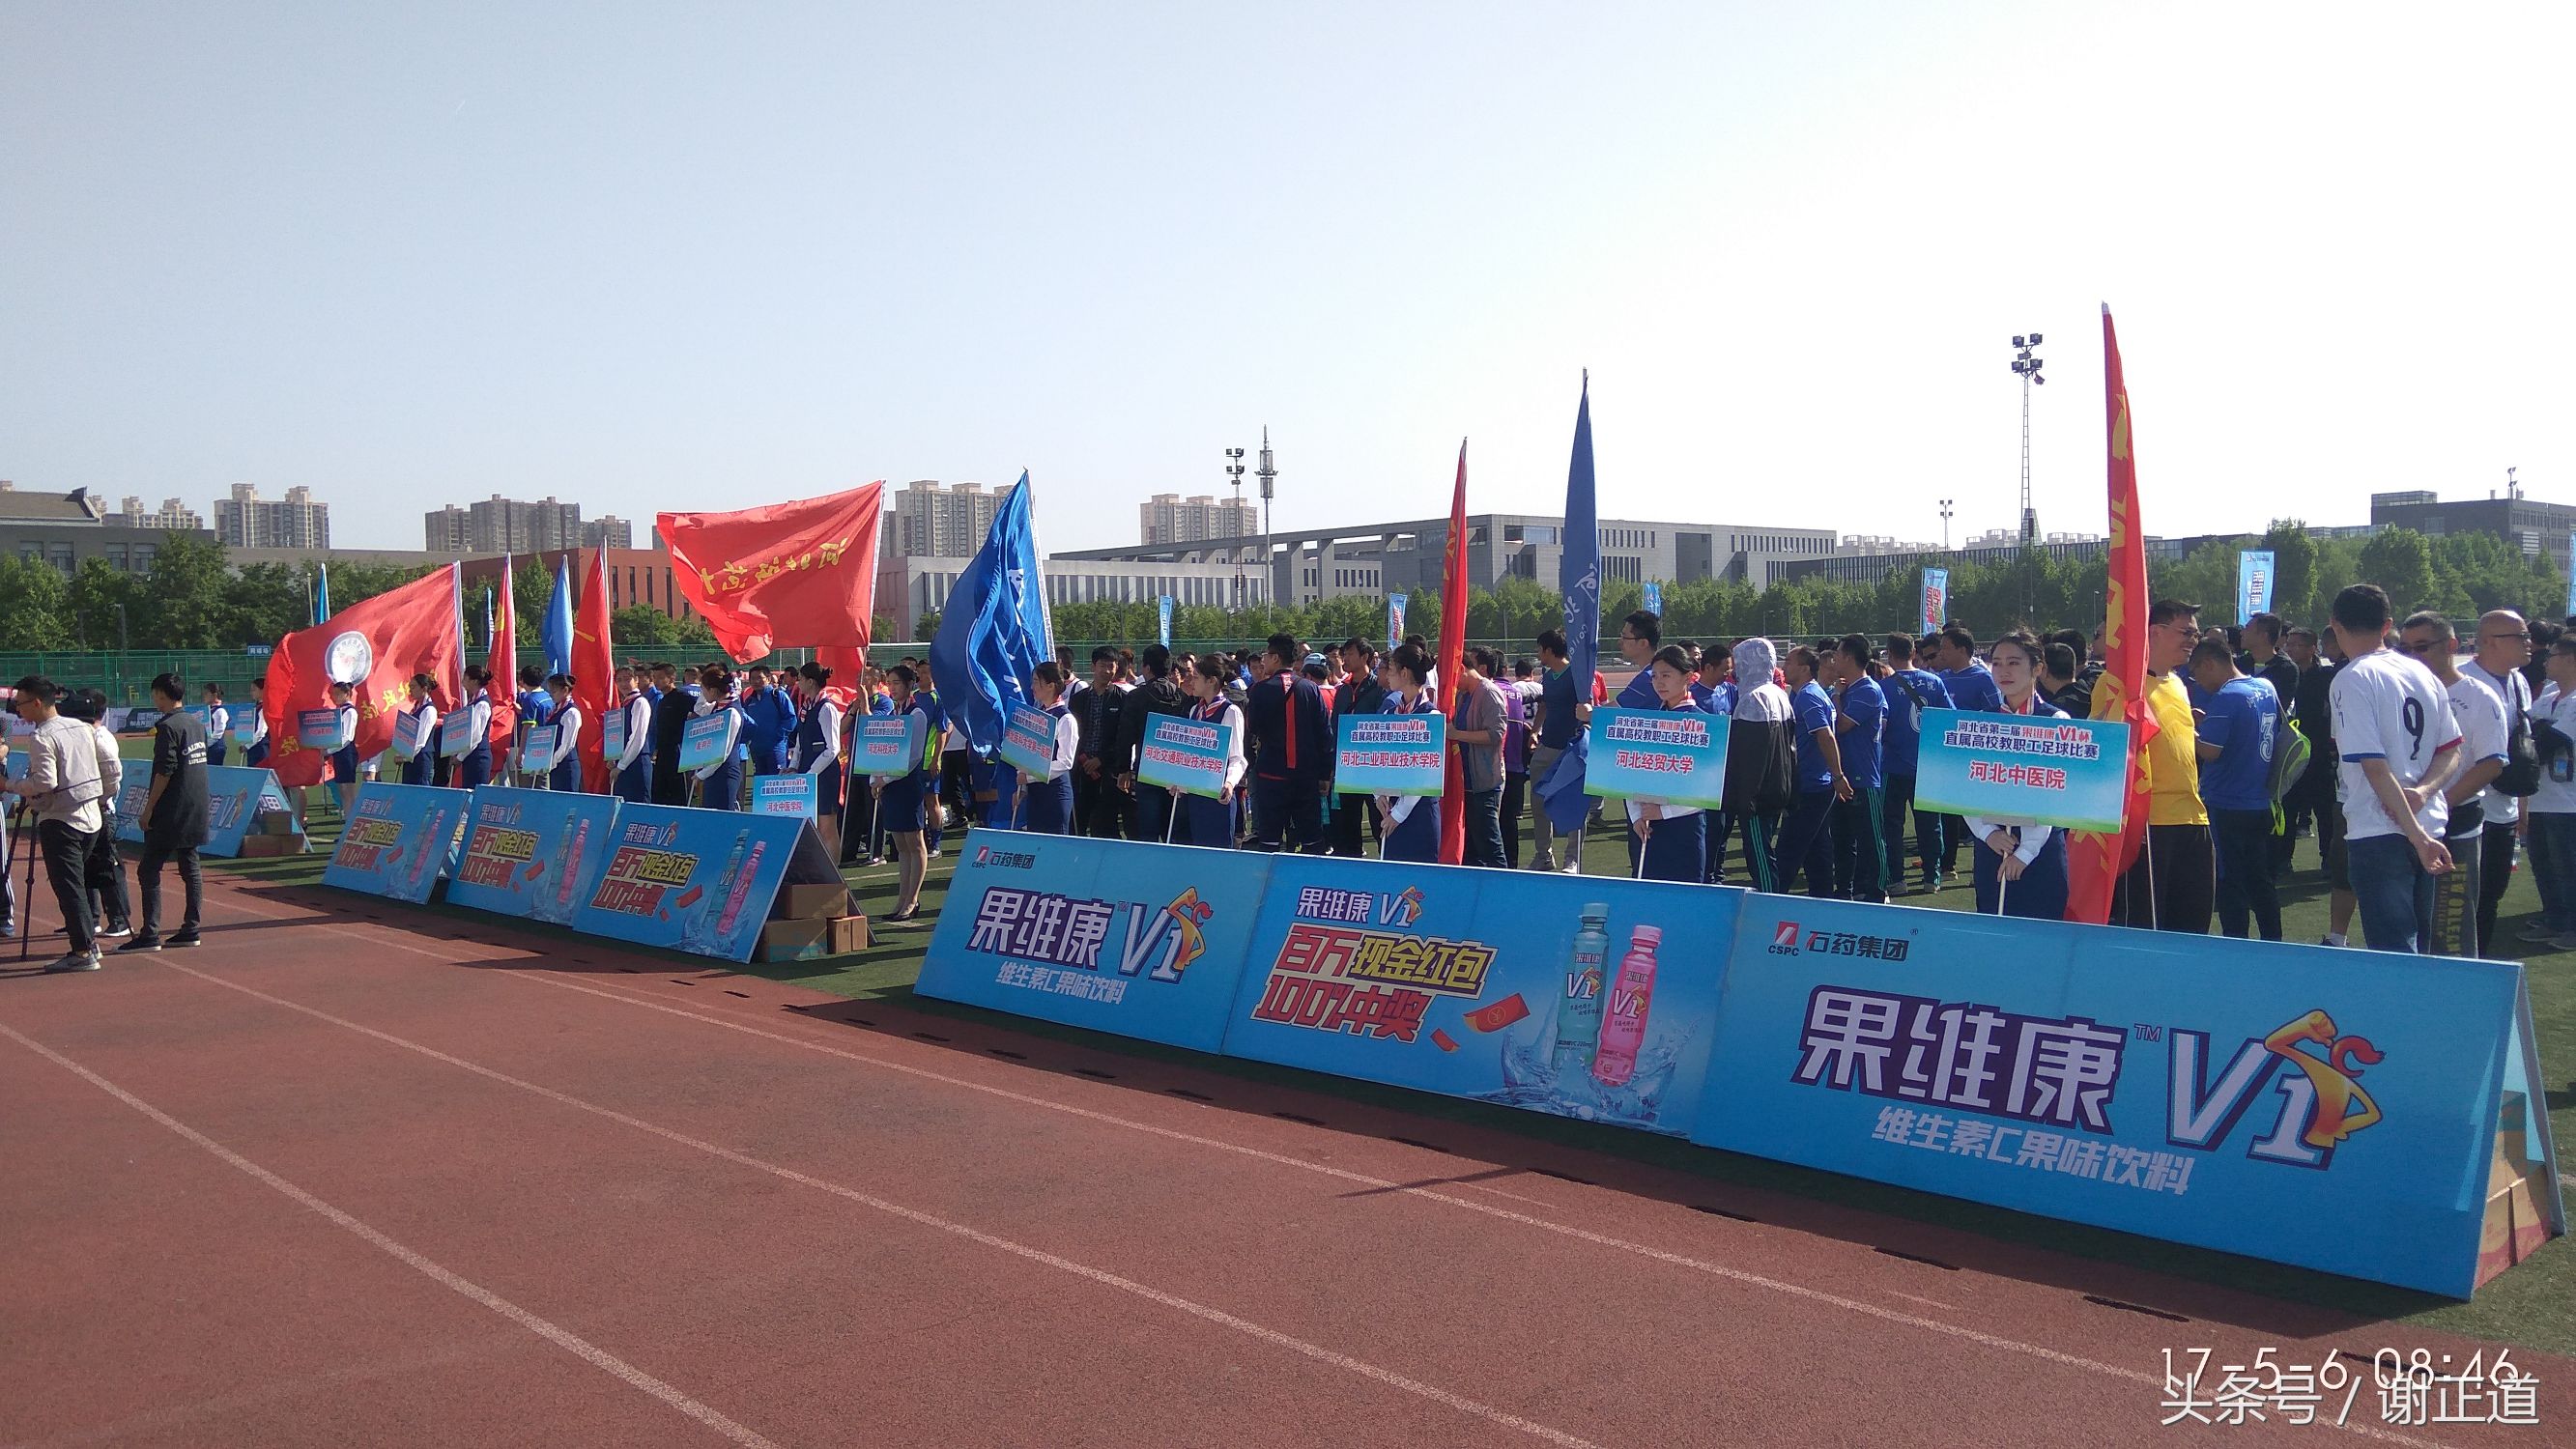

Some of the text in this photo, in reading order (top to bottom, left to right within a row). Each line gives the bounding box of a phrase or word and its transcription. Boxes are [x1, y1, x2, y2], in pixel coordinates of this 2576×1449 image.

[1606, 726, 1709, 747] 直属高校教职工足球比赛
[2260, 712, 2277, 762] 3
[2402, 687, 2424, 761] 9
[1945, 731, 2099, 758] 直属高校教职工足球比赛
[1144, 746, 1223, 774] 河北交通职业技术学院
[1341, 752, 1441, 768] 河北工业职业技术学院
[1616, 751, 1694, 774] 河北经贸大学
[1969, 761, 2066, 790] 河北中医院
[766, 801, 803, 812] 河北中医学院
[623, 823, 658, 844] 果维康
[971, 861, 987, 869] CSPC
[989, 850, 1036, 869] 石药集团
[1296, 887, 1413, 928] 果维康 V1
[967, 887, 1114, 969] 果维康
[1119, 902, 1184, 983] V1
[1805, 929, 1910, 962] 石药集团
[1274, 924, 1491, 991] 百万现金红包
[1767, 944, 1799, 957] CSPC
[995, 961, 1129, 1006] 维生素C果味饮料
[1566, 972, 1594, 1000] V1
[1613, 988, 1640, 1019] V1
[1792, 985, 2128, 1134] 果维康
[2166, 1027, 2334, 1171] V1
[1871, 1105, 2196, 1196] 维生素C果味饮料
